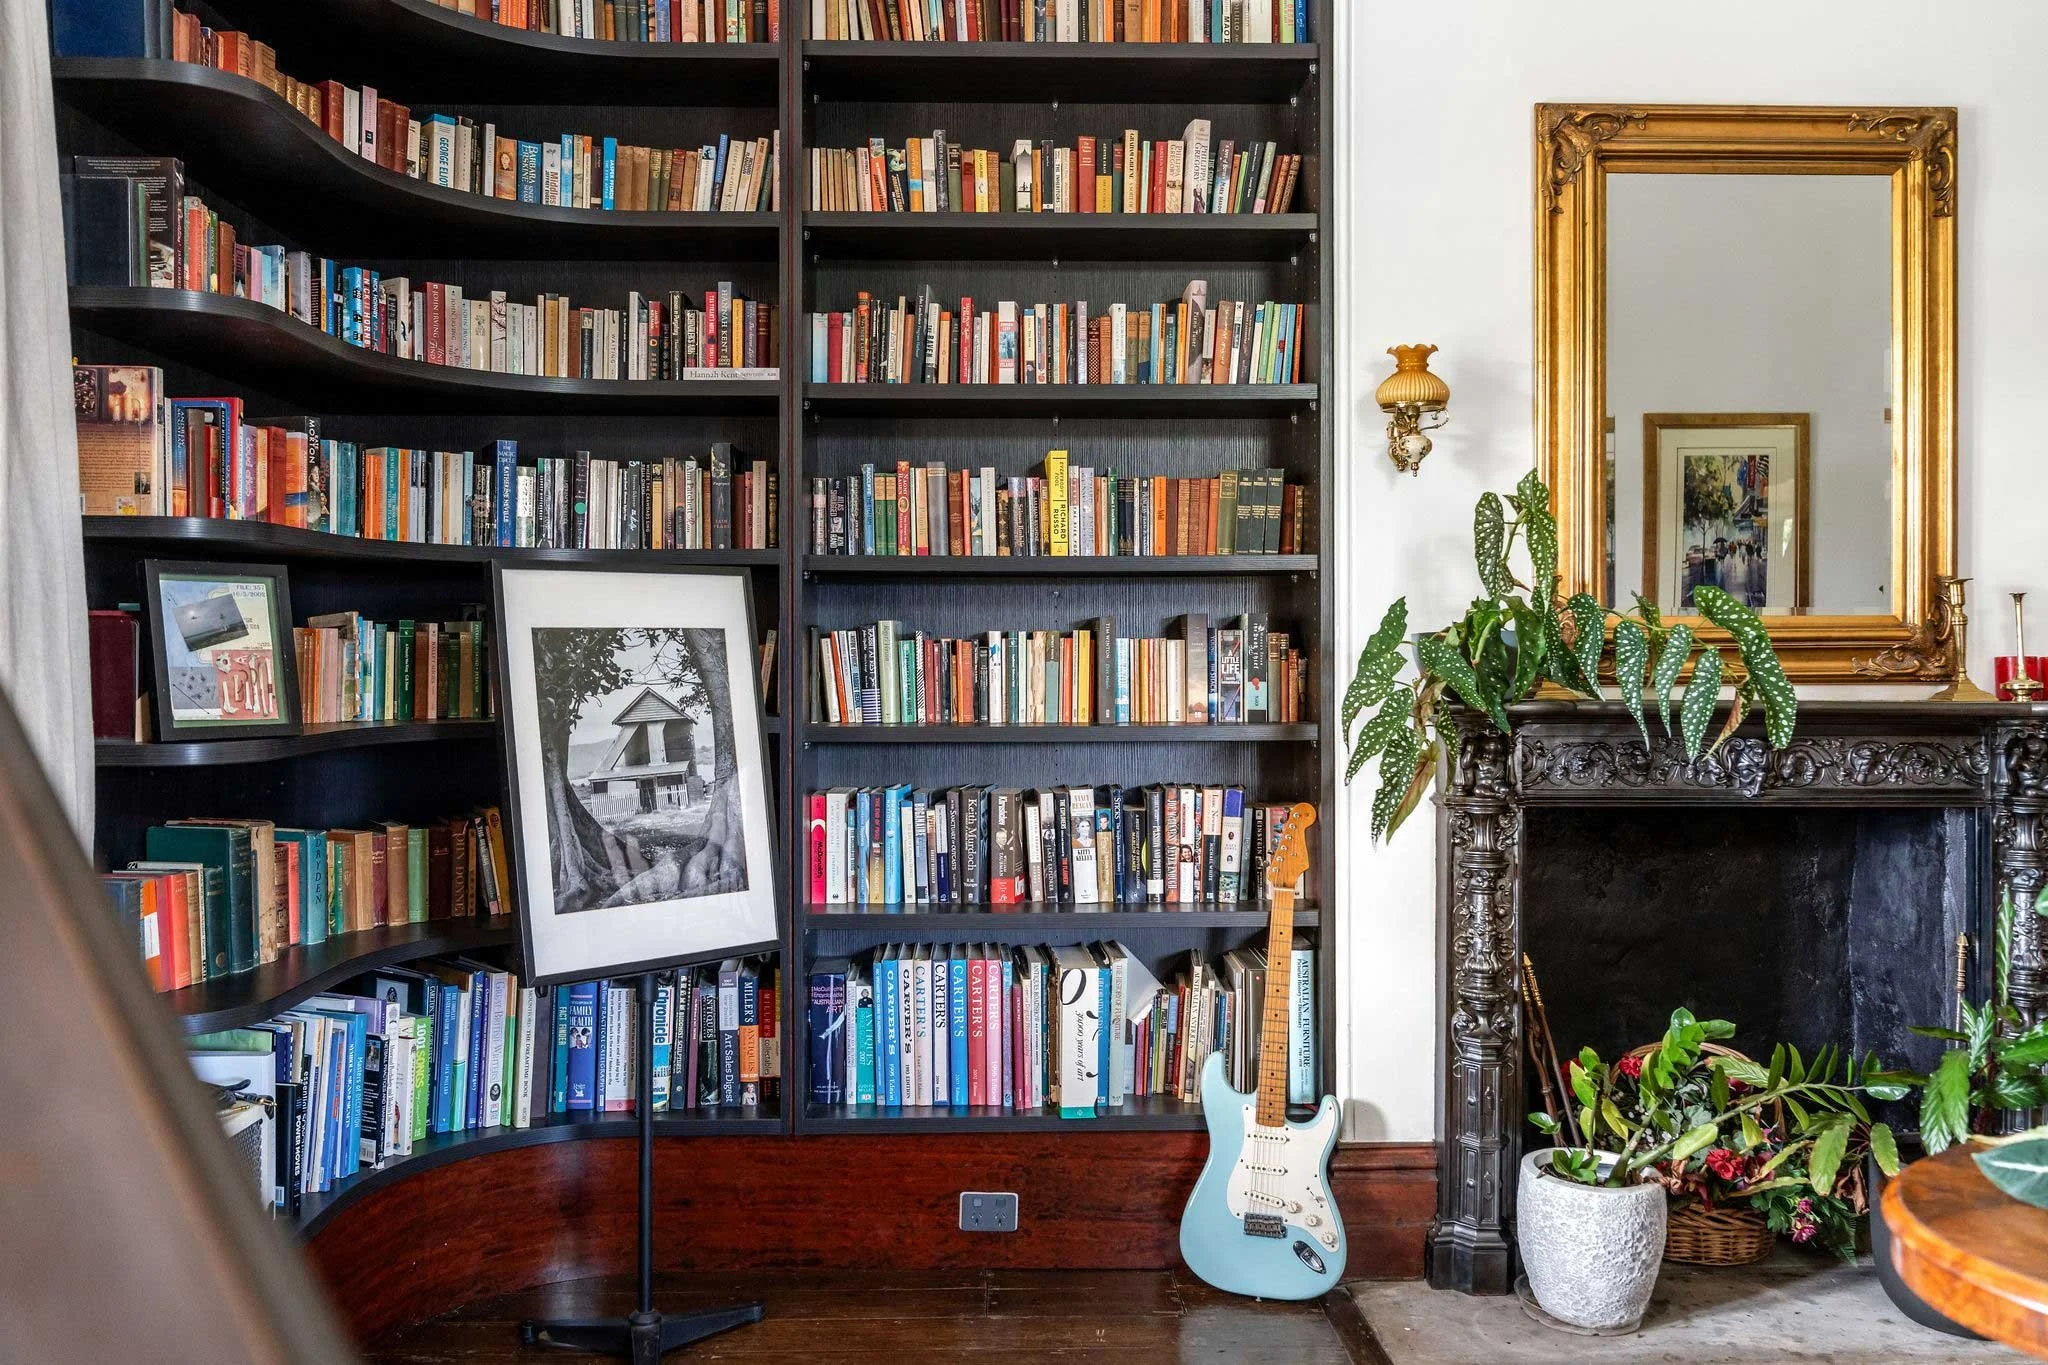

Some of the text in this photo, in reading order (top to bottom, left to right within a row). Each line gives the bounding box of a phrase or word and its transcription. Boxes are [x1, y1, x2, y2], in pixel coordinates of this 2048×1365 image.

[439, 137, 448, 187] GEORGE ELIOT
[521, 144, 530, 182] ERSKINE
[530, 146, 538, 183] BARBARA
[1192, 142, 1201, 182] GREGORY
[1200, 144, 1208, 181] PHILIPPA
[926, 335, 934, 358] RAVEN
[690, 370, 738, 379] Hannah Kent
[686, 465, 695, 514] Ann Patchett
[830, 490, 838, 517] SHRUGGED
[830, 534, 838, 548] RAND
[1222, 656, 1240, 664] LITTLE
[1222, 664, 1240, 674] LIFE
[914, 802, 926, 836] BOGANAIRE
[1072, 801, 1092, 809] REAGAN
[967, 798, 978, 871] Keith Murdoch
[1153, 826, 1162, 848] PASSION
[1076, 854, 1092, 862] KELLEY
[1168, 846, 1176, 889] NEVER ENOUGH
[455, 866, 464, 911] DONNE
[474, 982, 484, 1018] Maldives
[744, 982, 754, 1023] MILLER'S
[916, 966, 926, 1038] CARTER'S
[935, 964, 946, 1028] CARTER'S
[953, 965, 964, 1038] CARTER'S
[972, 965, 983, 1038] CARTER'S
[988, 965, 999, 1030] CARTER'S
[1302, 958, 1310, 1013] AUSTRALIAN
[558, 1006, 567, 1046] FACT FINDER
[569, 1005, 593, 1016] FAMILY
[569, 1016, 593, 1028] HEALTH
[655, 988, 670, 1044] Chronicle
[706, 995, 714, 1038] ANTIQUES
[826, 1005, 843, 1014] ART
[903, 968, 912, 1054] CARTER'S
[1189, 972, 1200, 1049] AUSTRALIAN ANTIQUES
[492, 980, 506, 1083] GREAT BRITISH WRITERS
[748, 1028, 756, 1072] ANTIQUES
[887, 970, 896, 1101] CARTER'S Edition
[356, 1056, 364, 1081] Masters
[415, 1023, 426, 1088] 1001 SONGS
[724, 1033, 734, 1102] Art Sales Digest
[764, 1039, 772, 1076] collectables
[1076, 1039, 1084, 1082] years of art
[302, 1071, 310, 1110] essential
[354, 1093, 362, 1128] DECEPTION
